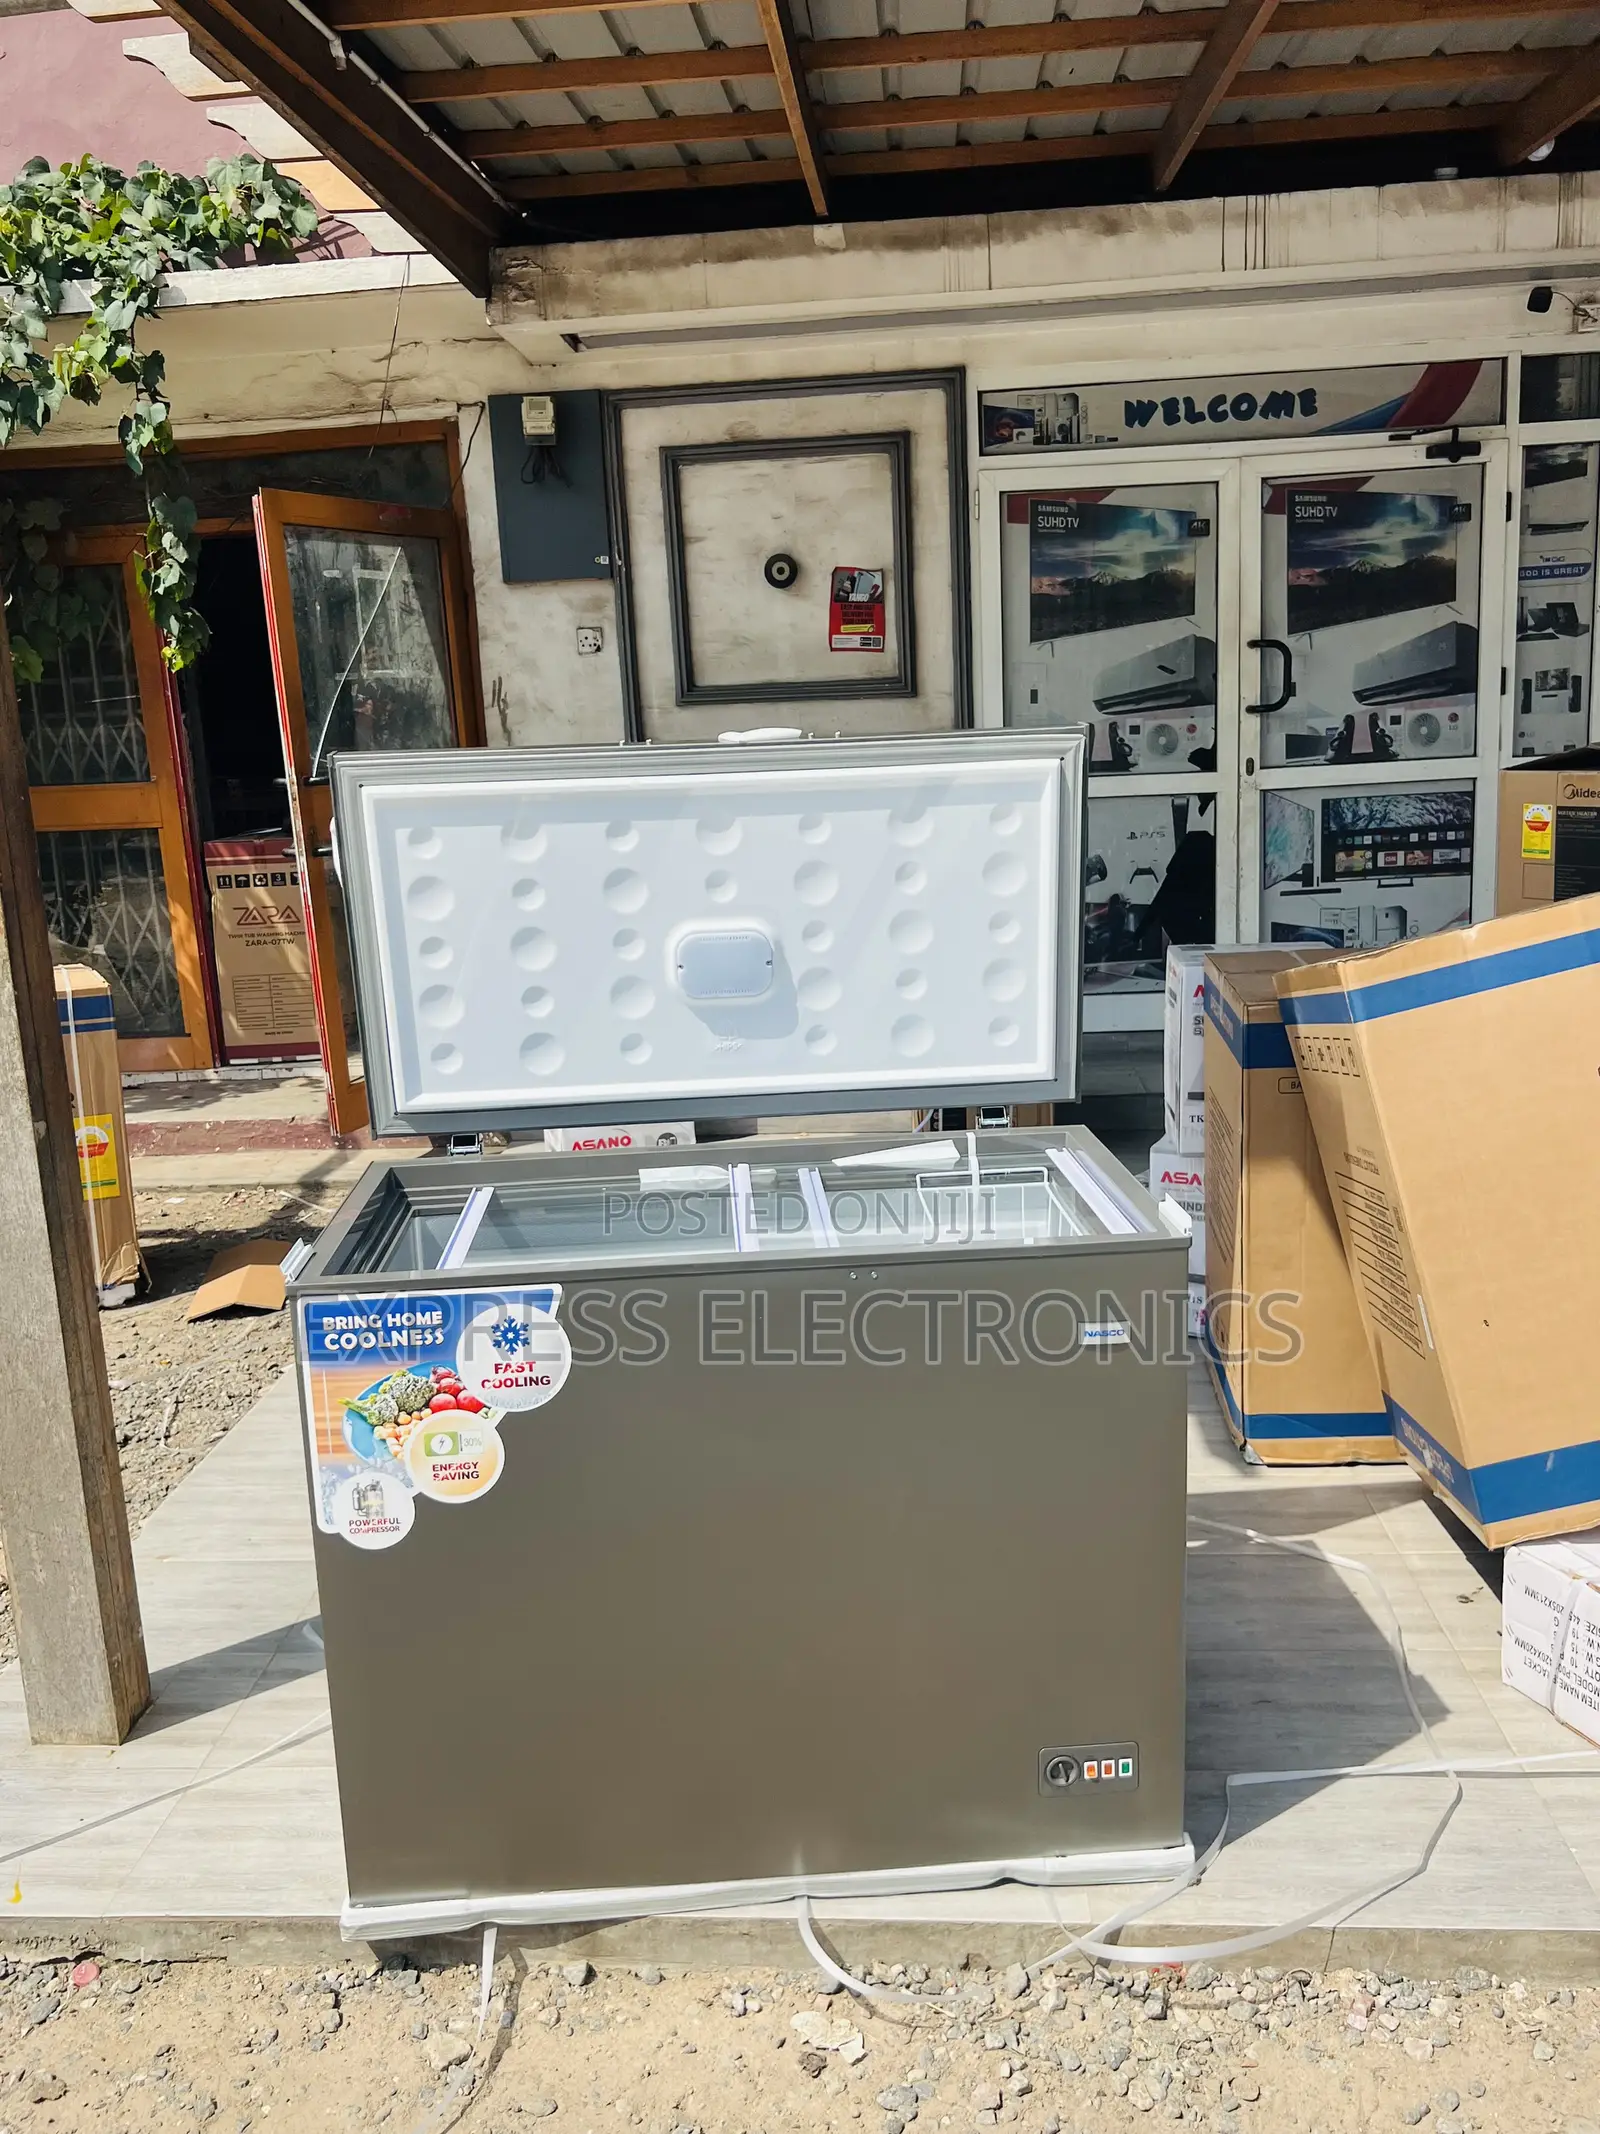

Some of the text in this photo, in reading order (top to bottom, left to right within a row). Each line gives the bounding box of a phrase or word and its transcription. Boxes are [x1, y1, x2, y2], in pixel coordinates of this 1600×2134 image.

[1124, 388, 1318, 428] WELCOME
[1037, 505, 1069, 513] SAMSUNG
[1553, 566, 1585, 576] GREAT
[233, 904, 301, 926] ZARA
[245, 938, 296, 947] ZARA-07TW
[1290, 1080, 1303, 1090] BA
[1188, 1114, 1205, 1123] TK
[572, 1135, 632, 1151] ASANO
[1160, 1170, 1203, 1186] ASA
[322, 1310, 443, 1331] BRING HOME
[323, 1326, 445, 1351] COOLNESS
[1083, 1329, 1125, 1338] NASCO
[494, 1361, 537, 1375] FAST
[481, 1375, 551, 1390] COOLING
[463, 1436, 482, 1447] 30%
[432, 1461, 479, 1472] ENERGY
[433, 1470, 480, 1481] SAVING
[349, 1517, 402, 1527] POWERFUL
[349, 1525, 401, 1535] COMPRESSOR
[1581, 1690, 1600, 1712] ITEM
